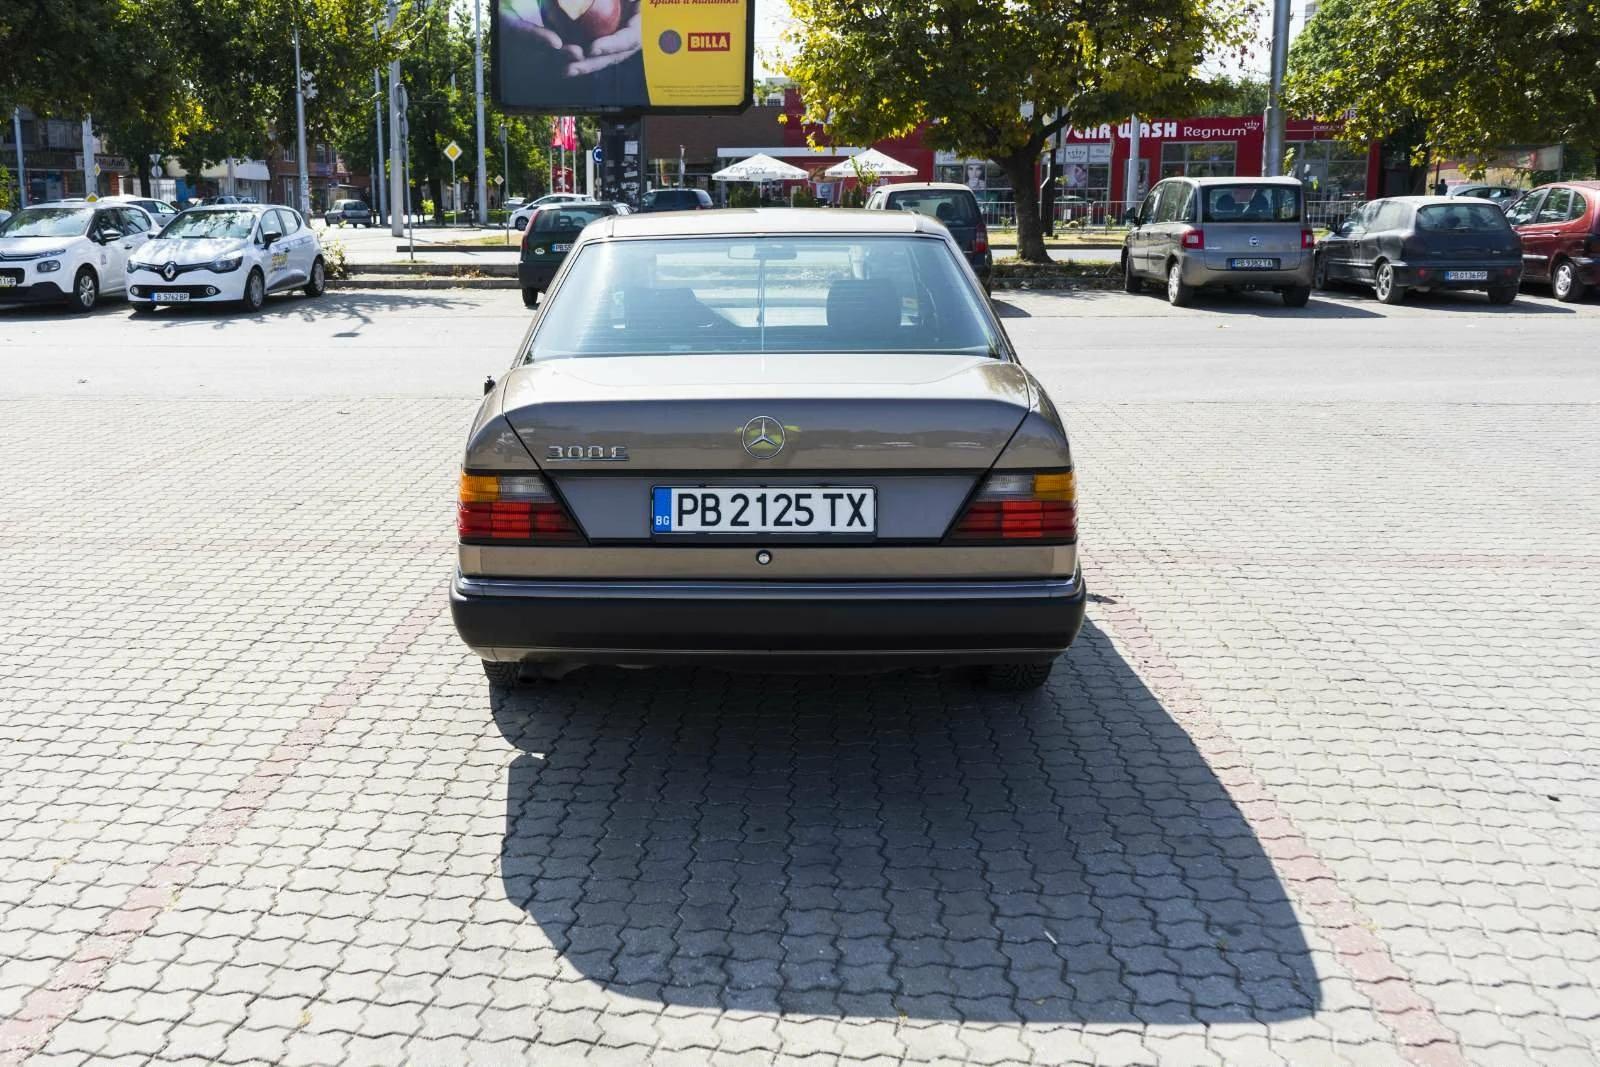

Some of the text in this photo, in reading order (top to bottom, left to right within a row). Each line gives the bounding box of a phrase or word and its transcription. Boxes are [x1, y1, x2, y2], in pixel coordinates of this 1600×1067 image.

[690, 35, 728, 48] BILLA
[1073, 122, 1177, 139] CAR WASH
[1183, 126, 1247, 139] Regnum
[548, 445, 628, 459] 300 E
[677, 493, 867, 527] PB 2125 TX
[656, 516, 670, 526] BG
